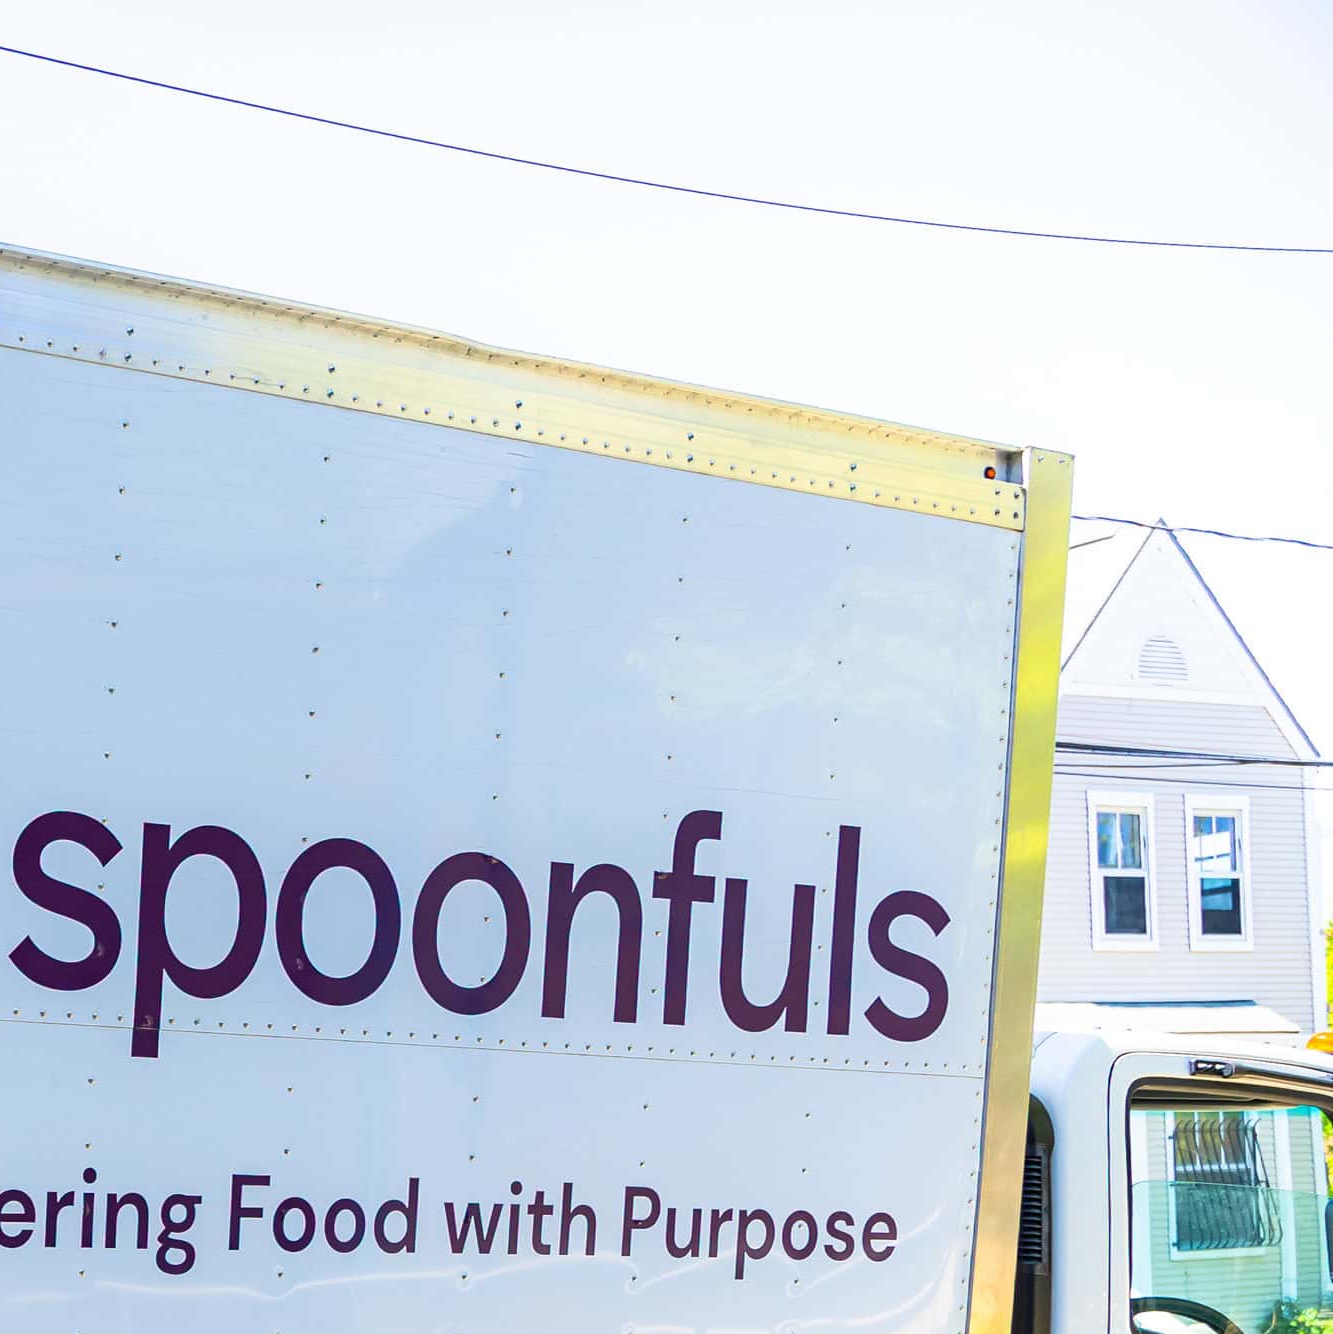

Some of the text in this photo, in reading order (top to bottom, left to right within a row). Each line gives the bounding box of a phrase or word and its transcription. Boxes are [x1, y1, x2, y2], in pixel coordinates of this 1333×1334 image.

[9, 810, 950, 1058] spoonfuls
[229, 1175, 419, 1254] Food
[445, 1183, 597, 1256] with
[621, 1187, 897, 1280] Purpose
